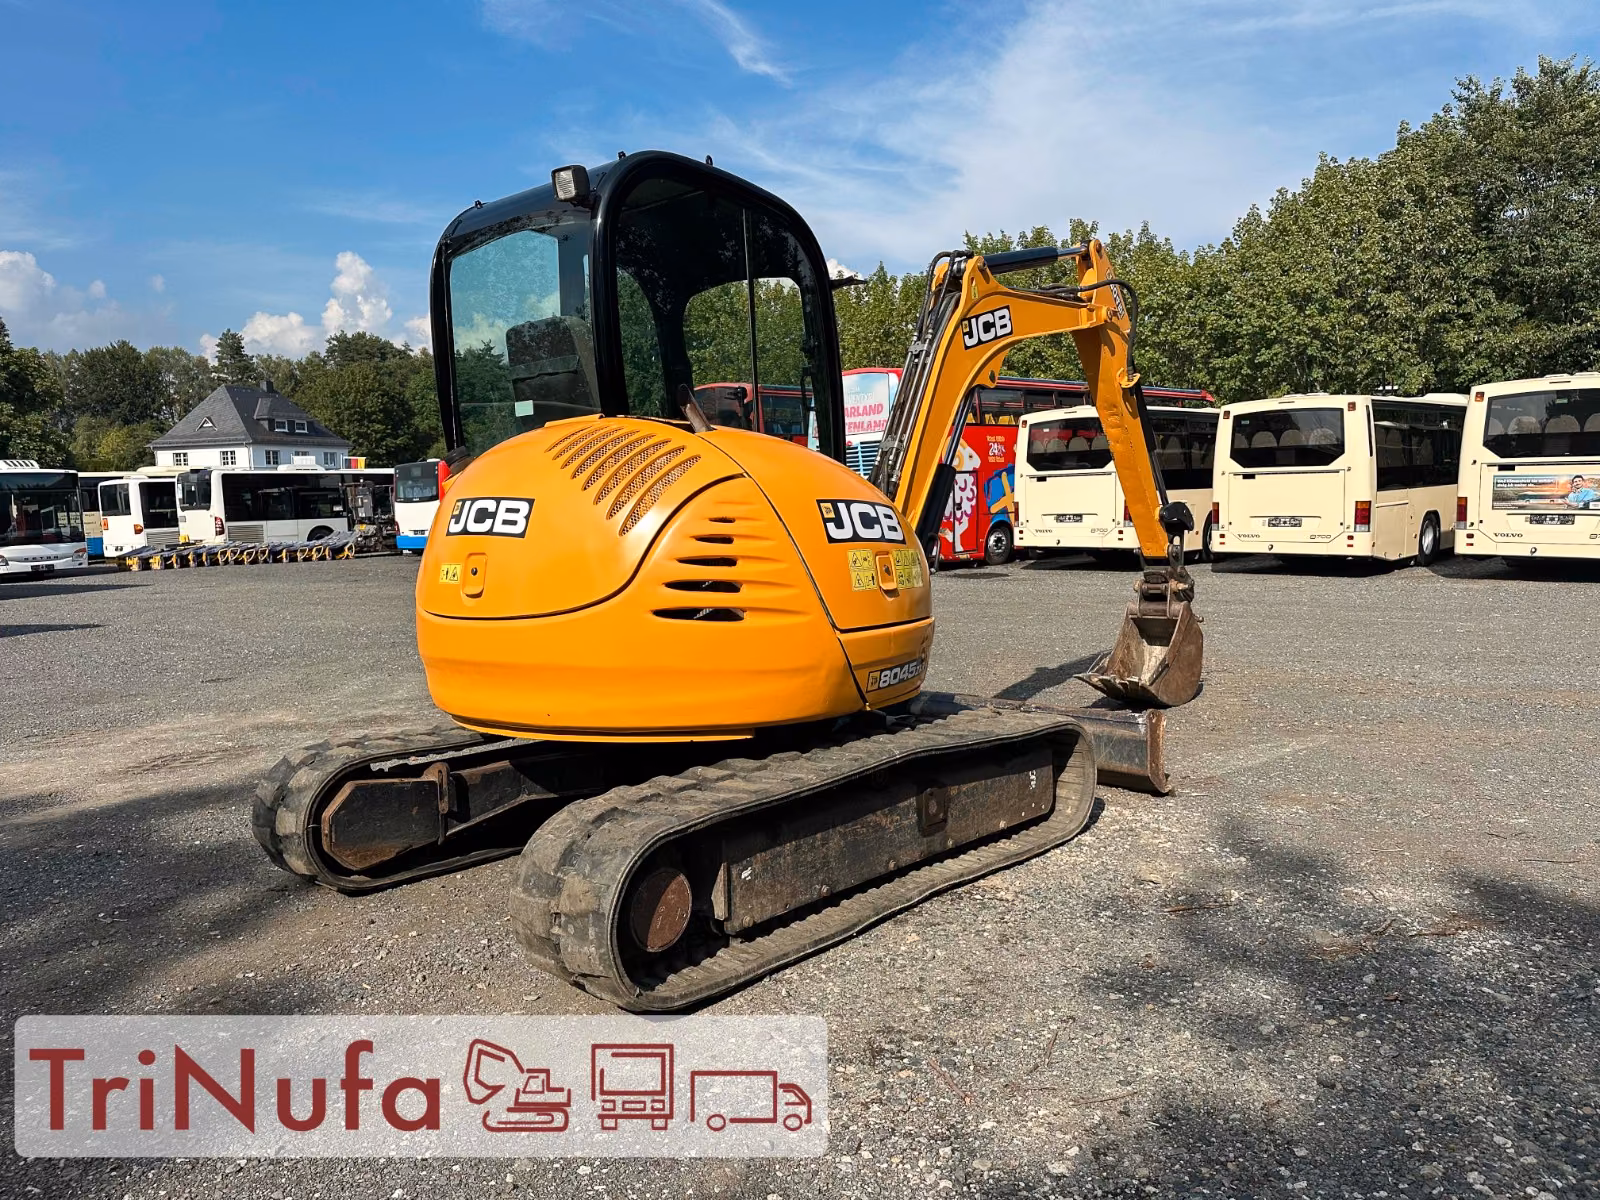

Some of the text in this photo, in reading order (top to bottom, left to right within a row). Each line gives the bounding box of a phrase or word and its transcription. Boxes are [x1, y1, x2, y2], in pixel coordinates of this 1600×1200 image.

[963, 308, 1012, 347] JCB
[448, 499, 530, 534] JCB
[825, 502, 904, 541] JCB
